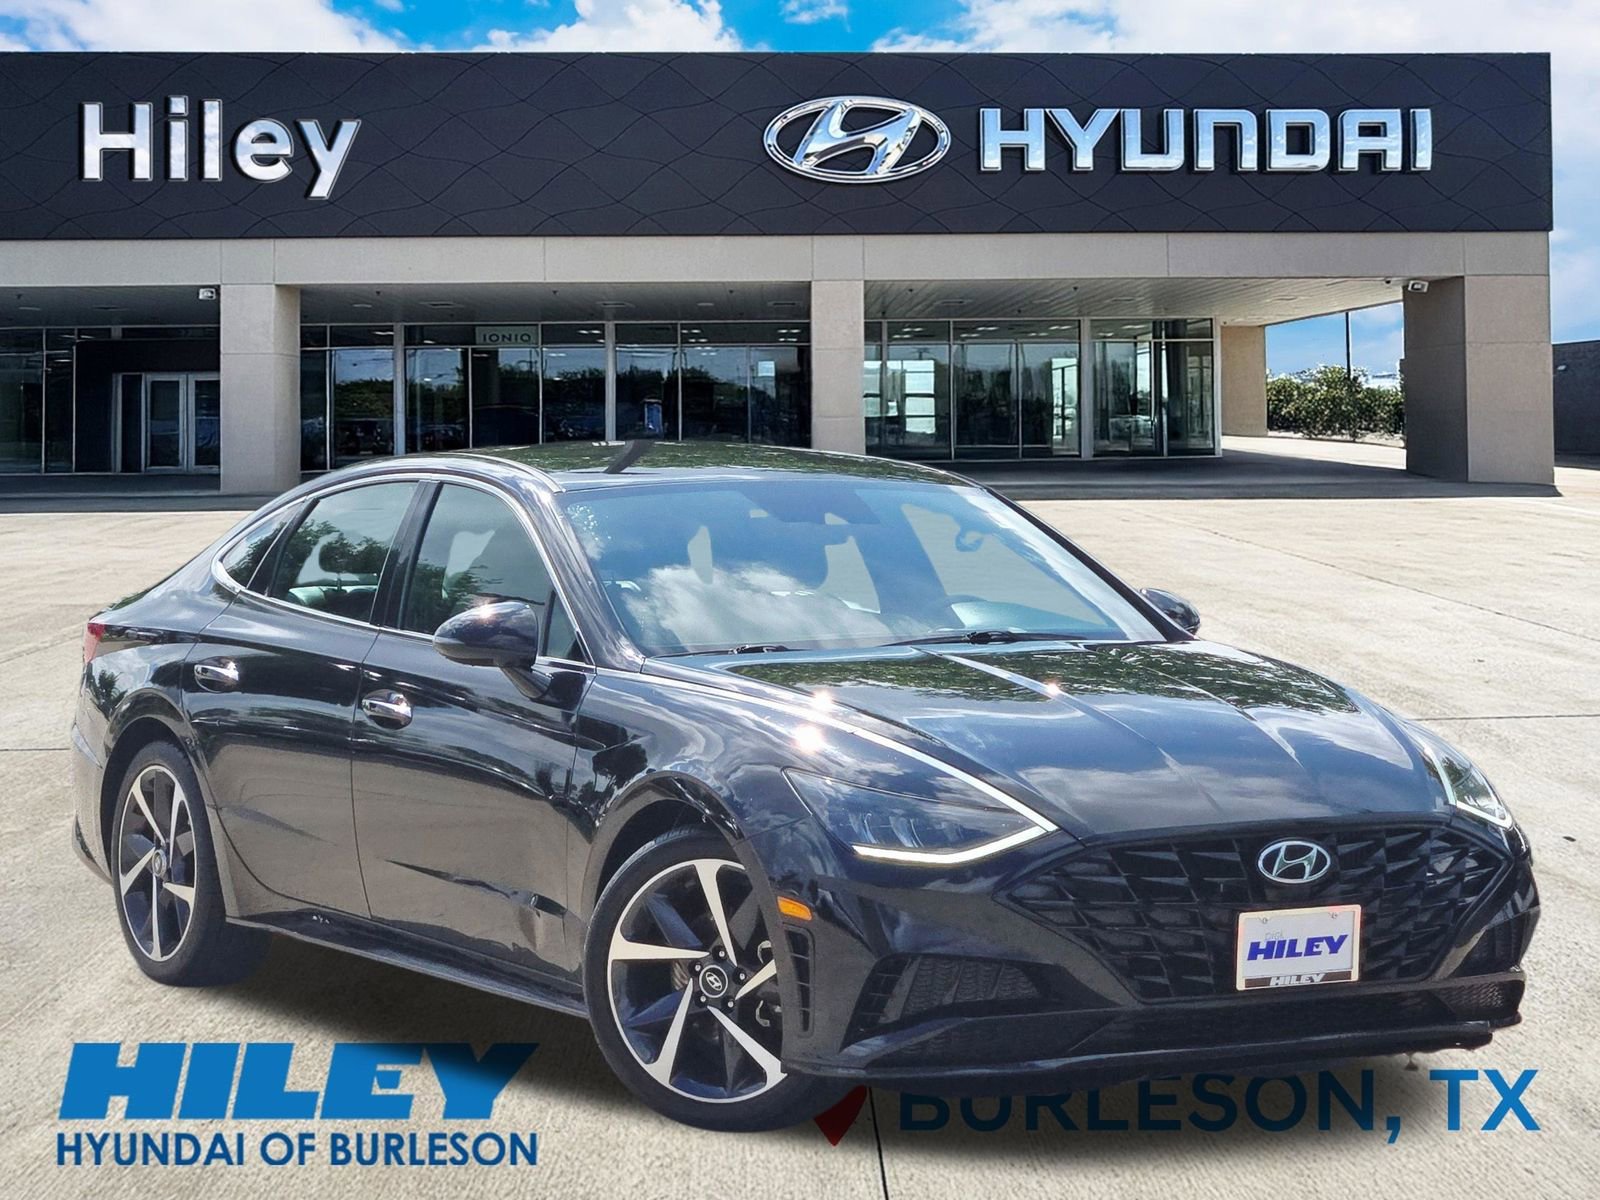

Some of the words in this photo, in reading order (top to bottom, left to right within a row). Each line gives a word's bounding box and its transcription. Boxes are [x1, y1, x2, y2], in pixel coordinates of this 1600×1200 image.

[79, 95, 362, 199] Hiley
[979, 107, 1432, 172] HYUNDAI
[482, 332, 532, 343] IONIQ
[1247, 934, 1349, 961] HILEY
[1269, 973, 1325, 987] HILEY
